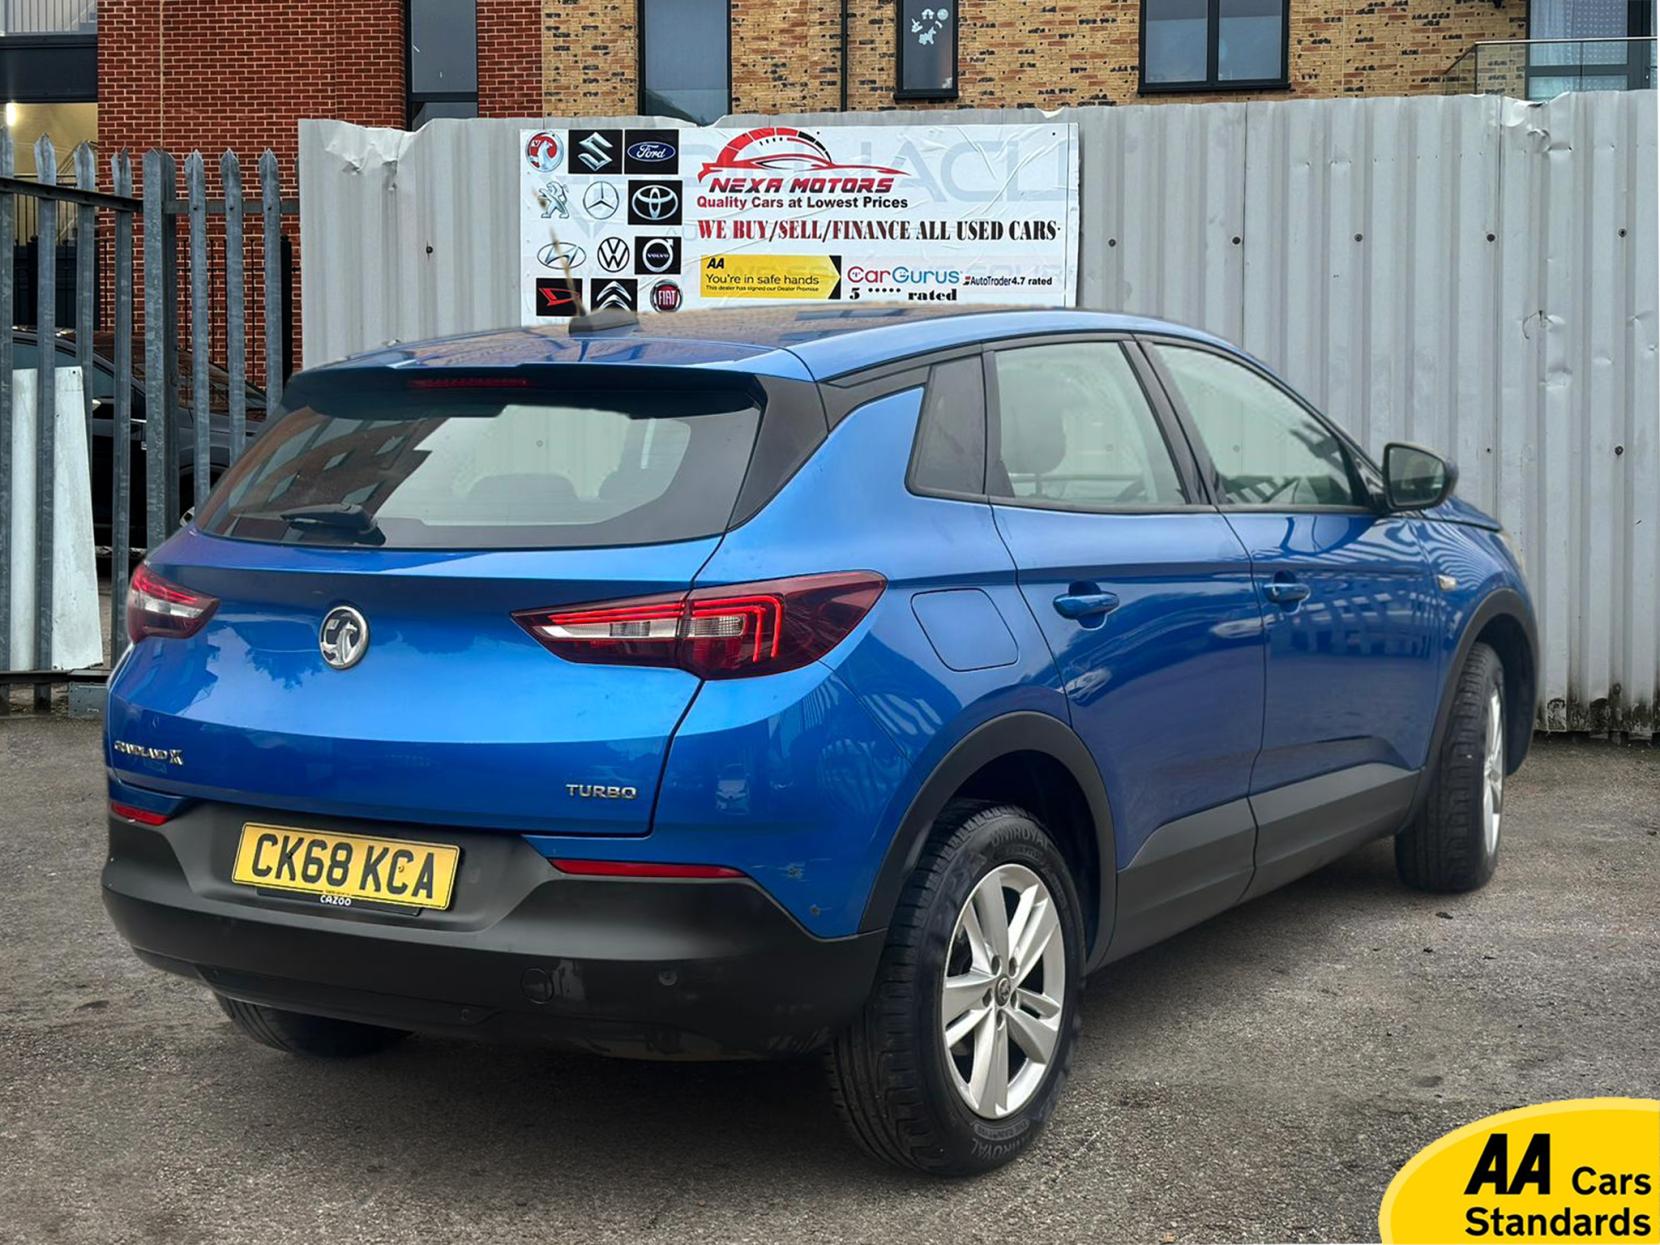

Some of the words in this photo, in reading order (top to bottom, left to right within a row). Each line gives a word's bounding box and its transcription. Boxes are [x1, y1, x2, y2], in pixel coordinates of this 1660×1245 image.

[636, 144, 666, 159] Ford
[709, 178, 784, 194] NEXA
[789, 178, 895, 194] MOTORS
[697, 196, 747, 210] Quality
[752, 197, 784, 208] Cars
[788, 198, 803, 208] at
[807, 196, 858, 208] Lowest
[863, 196, 908, 208] Prices
[698, 220, 727, 239] WE
[916, 221, 951, 240] ALL
[957, 221, 1004, 240] USED
[1009, 220, 1057, 240] CARS
[706, 258, 725, 269] AA
[706, 273, 741, 285] You're
[744, 274, 755, 284] in
[757, 274, 781, 285] safe
[783, 274, 820, 285] hands
[847, 266, 960, 284] CarGurus
[1028, 277, 1053, 286] rated
[658, 289, 676, 306] FIAT
[849, 287, 860, 300] 5
[908, 289, 958, 301] rated
[565, 783, 637, 799] TURBO
[251, 833, 354, 888] CK68
[358, 845, 436, 900] KCA
[320, 894, 352, 906] CAZOO
